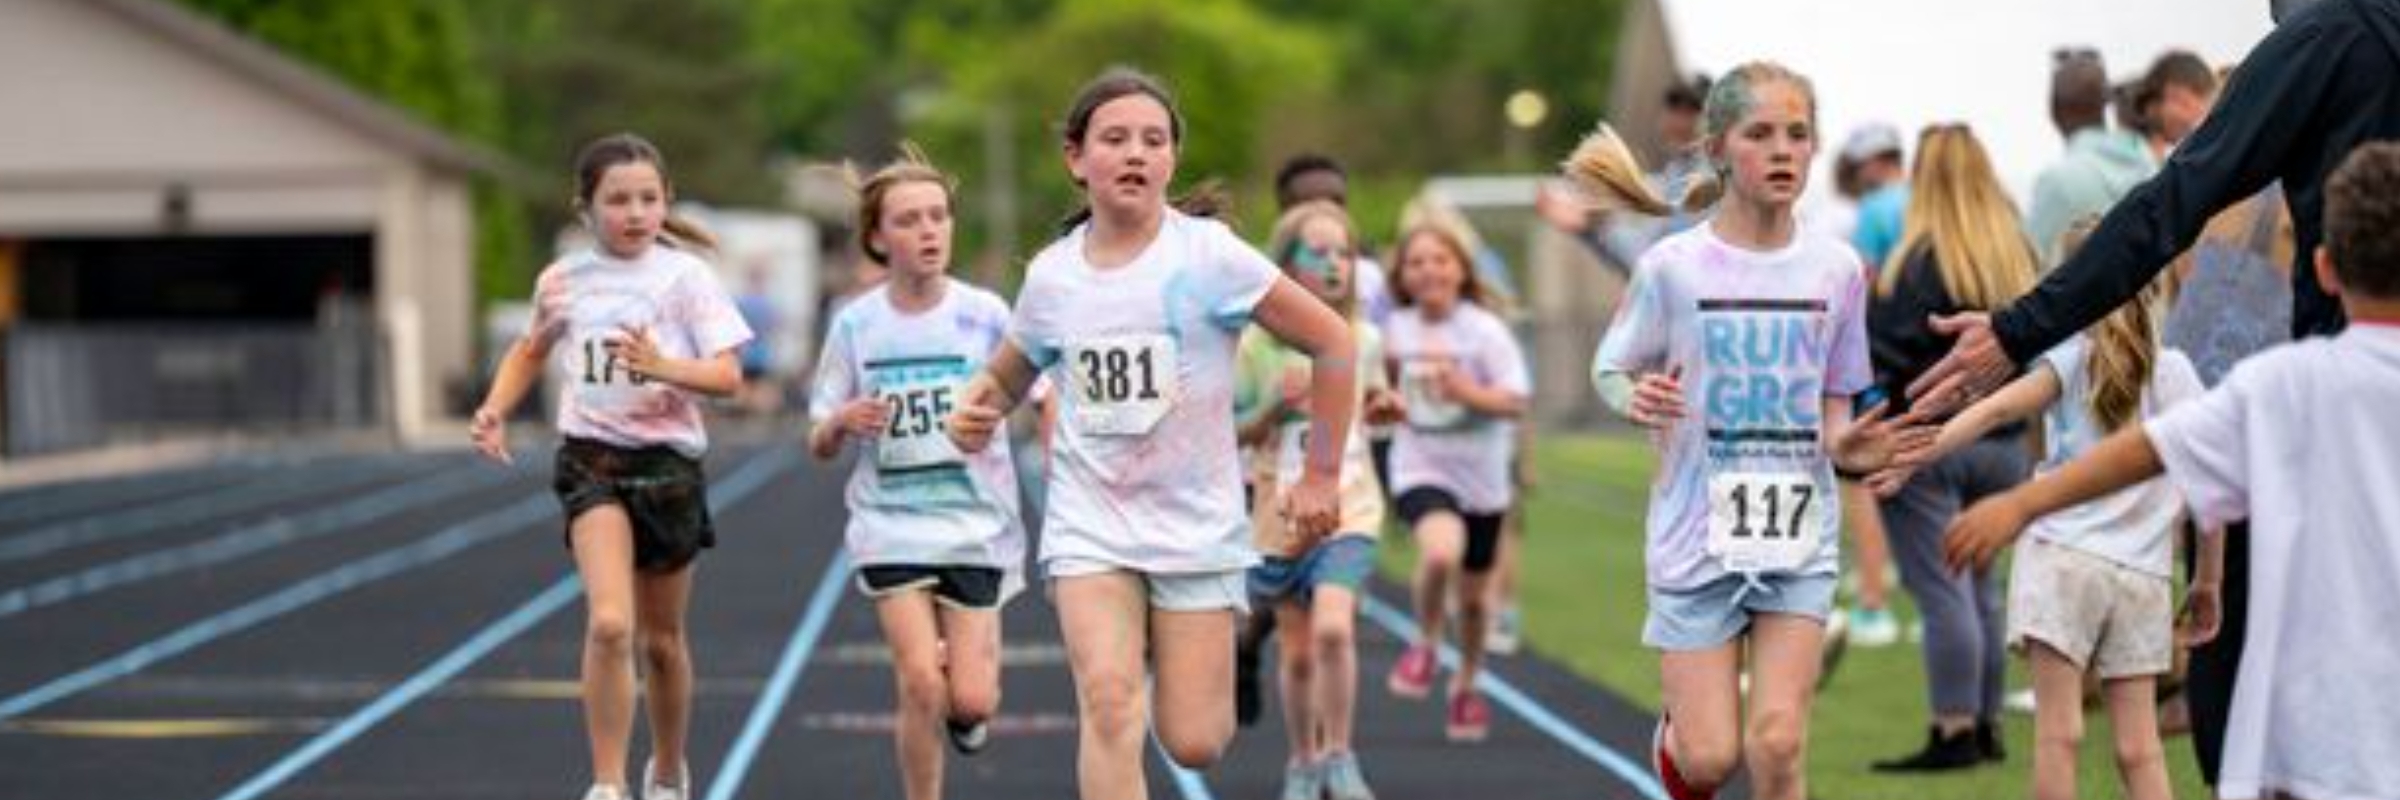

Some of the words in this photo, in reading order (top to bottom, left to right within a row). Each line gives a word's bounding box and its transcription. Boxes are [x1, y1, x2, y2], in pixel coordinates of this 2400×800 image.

[1704, 317, 1825, 367] RUN
[1079, 347, 1159, 402] 381
[1729, 483, 1813, 540] 117
